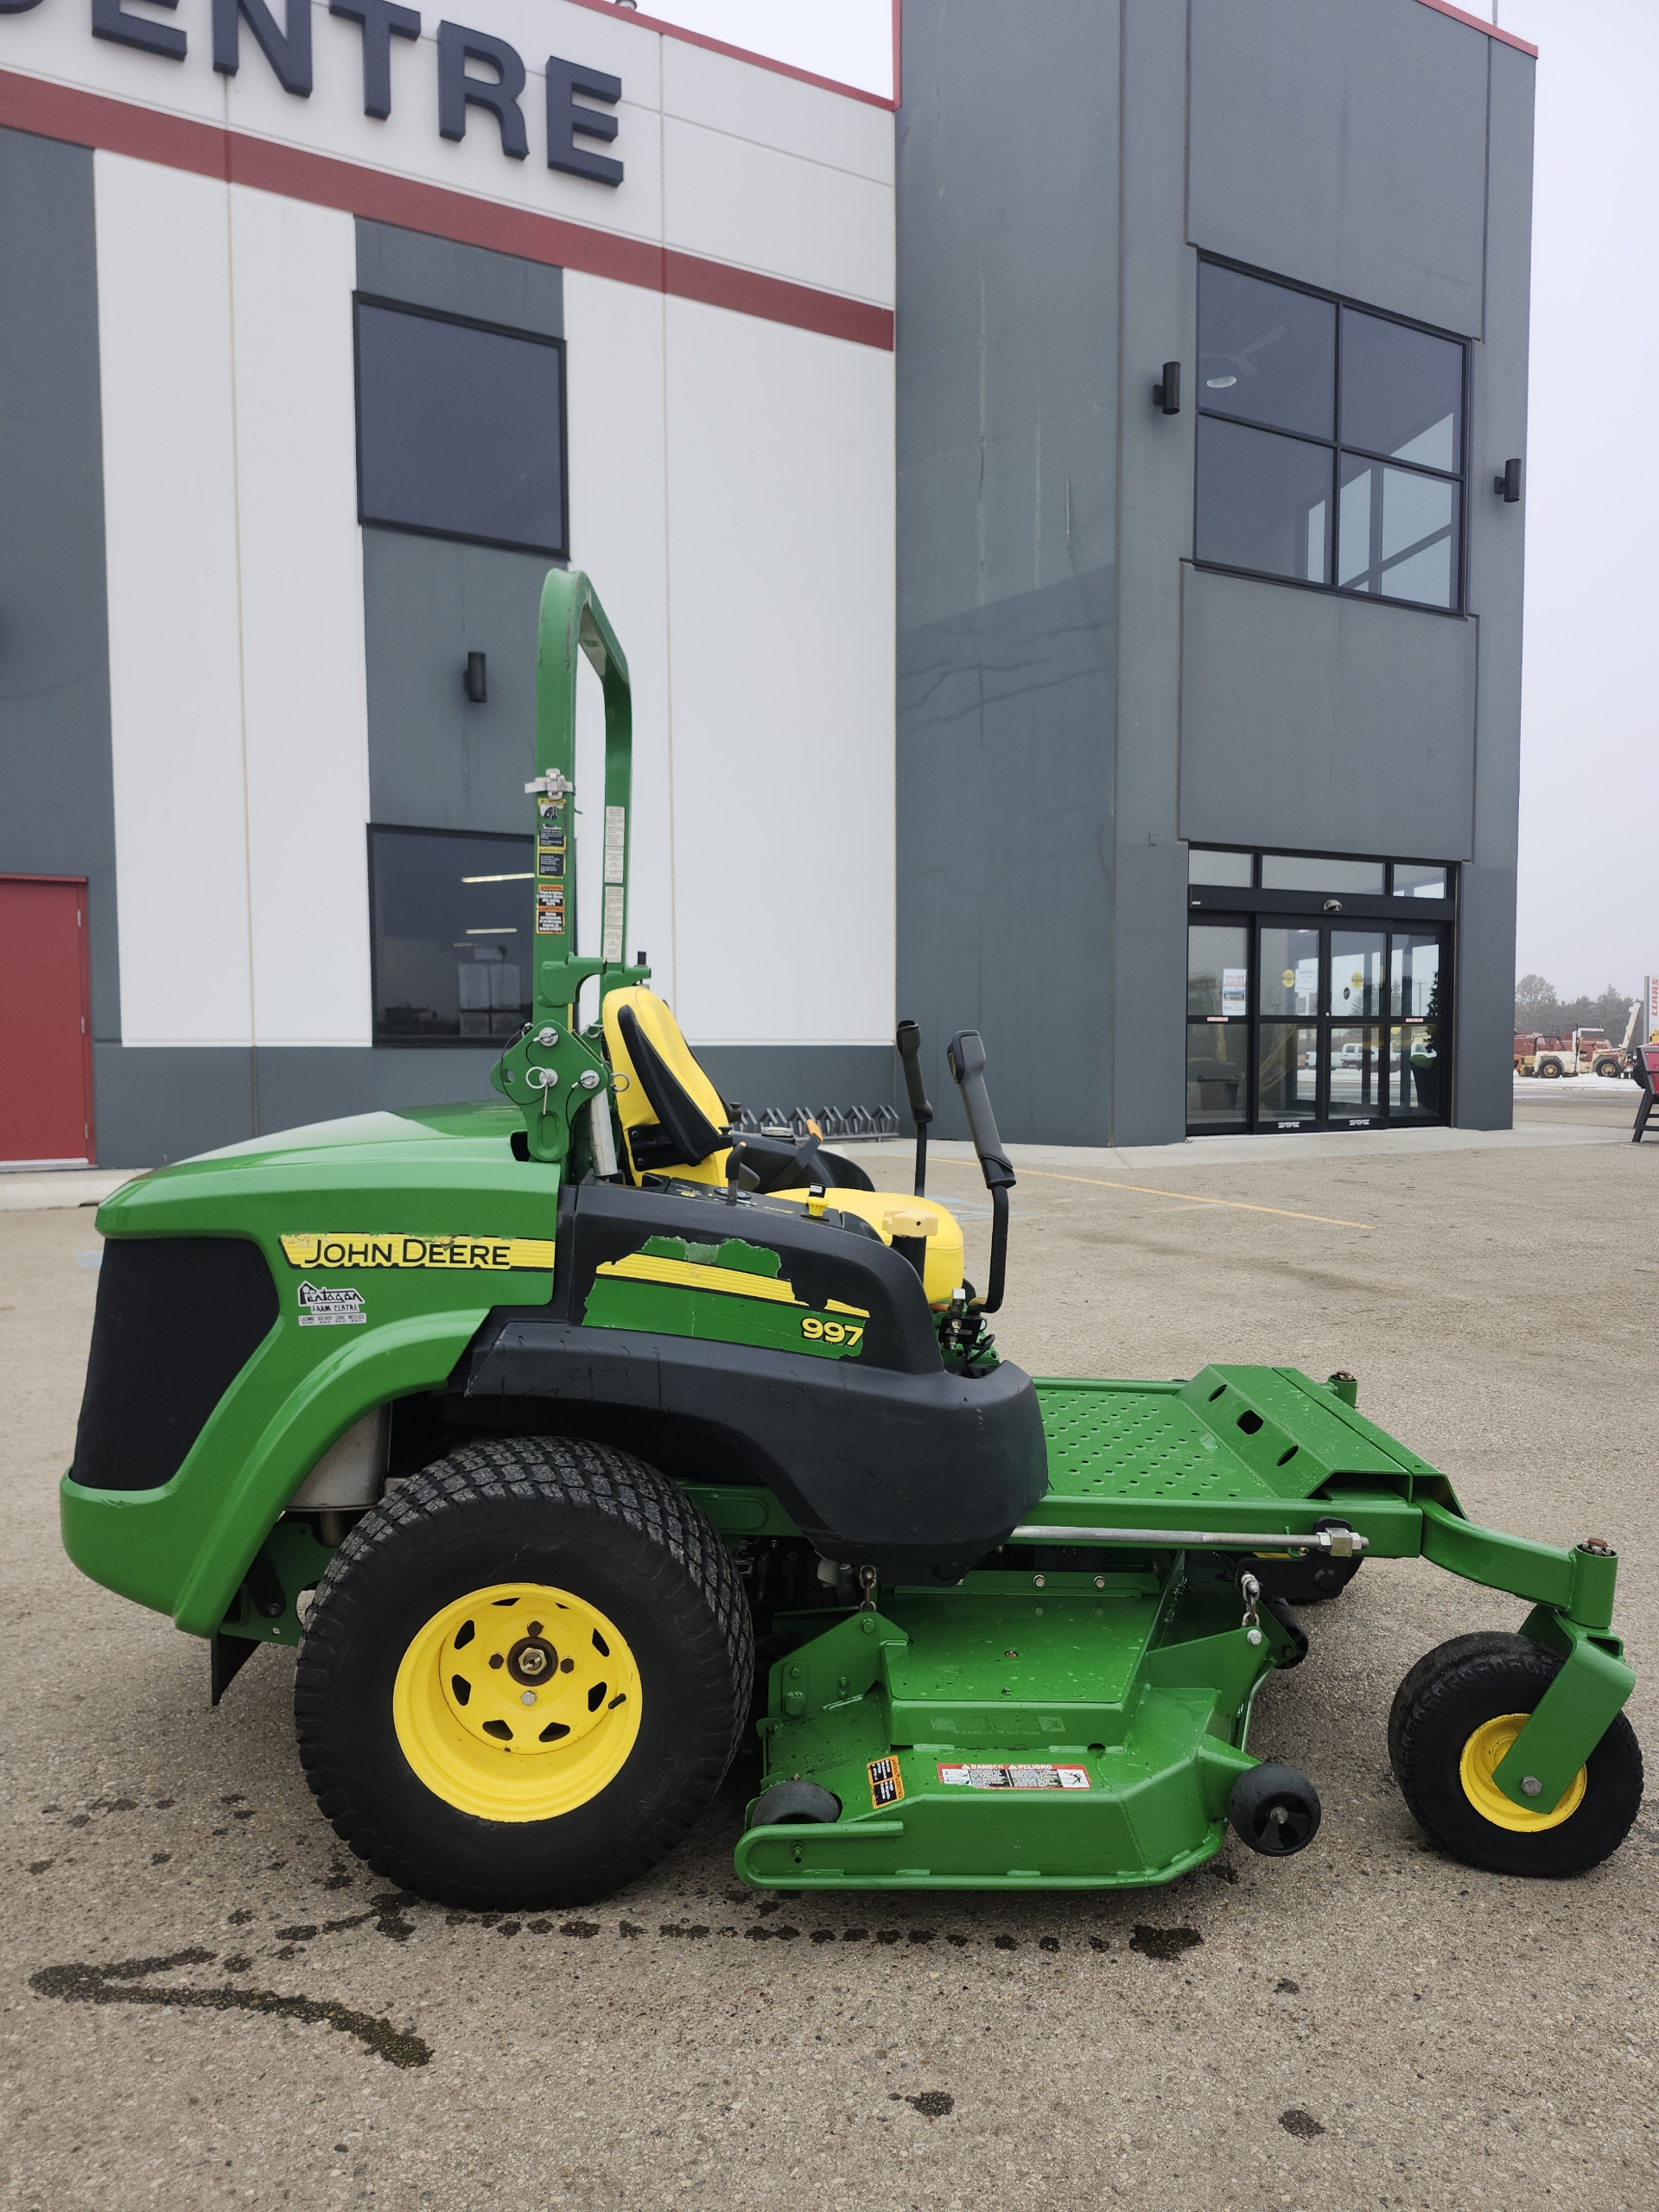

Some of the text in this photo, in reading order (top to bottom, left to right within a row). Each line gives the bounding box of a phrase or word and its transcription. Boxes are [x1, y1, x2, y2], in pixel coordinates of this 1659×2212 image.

[0, 0, 624, 188] NTRE
[305, 1238, 512, 1266] JOHN DEERE
[800, 1317, 864, 1347] 997
